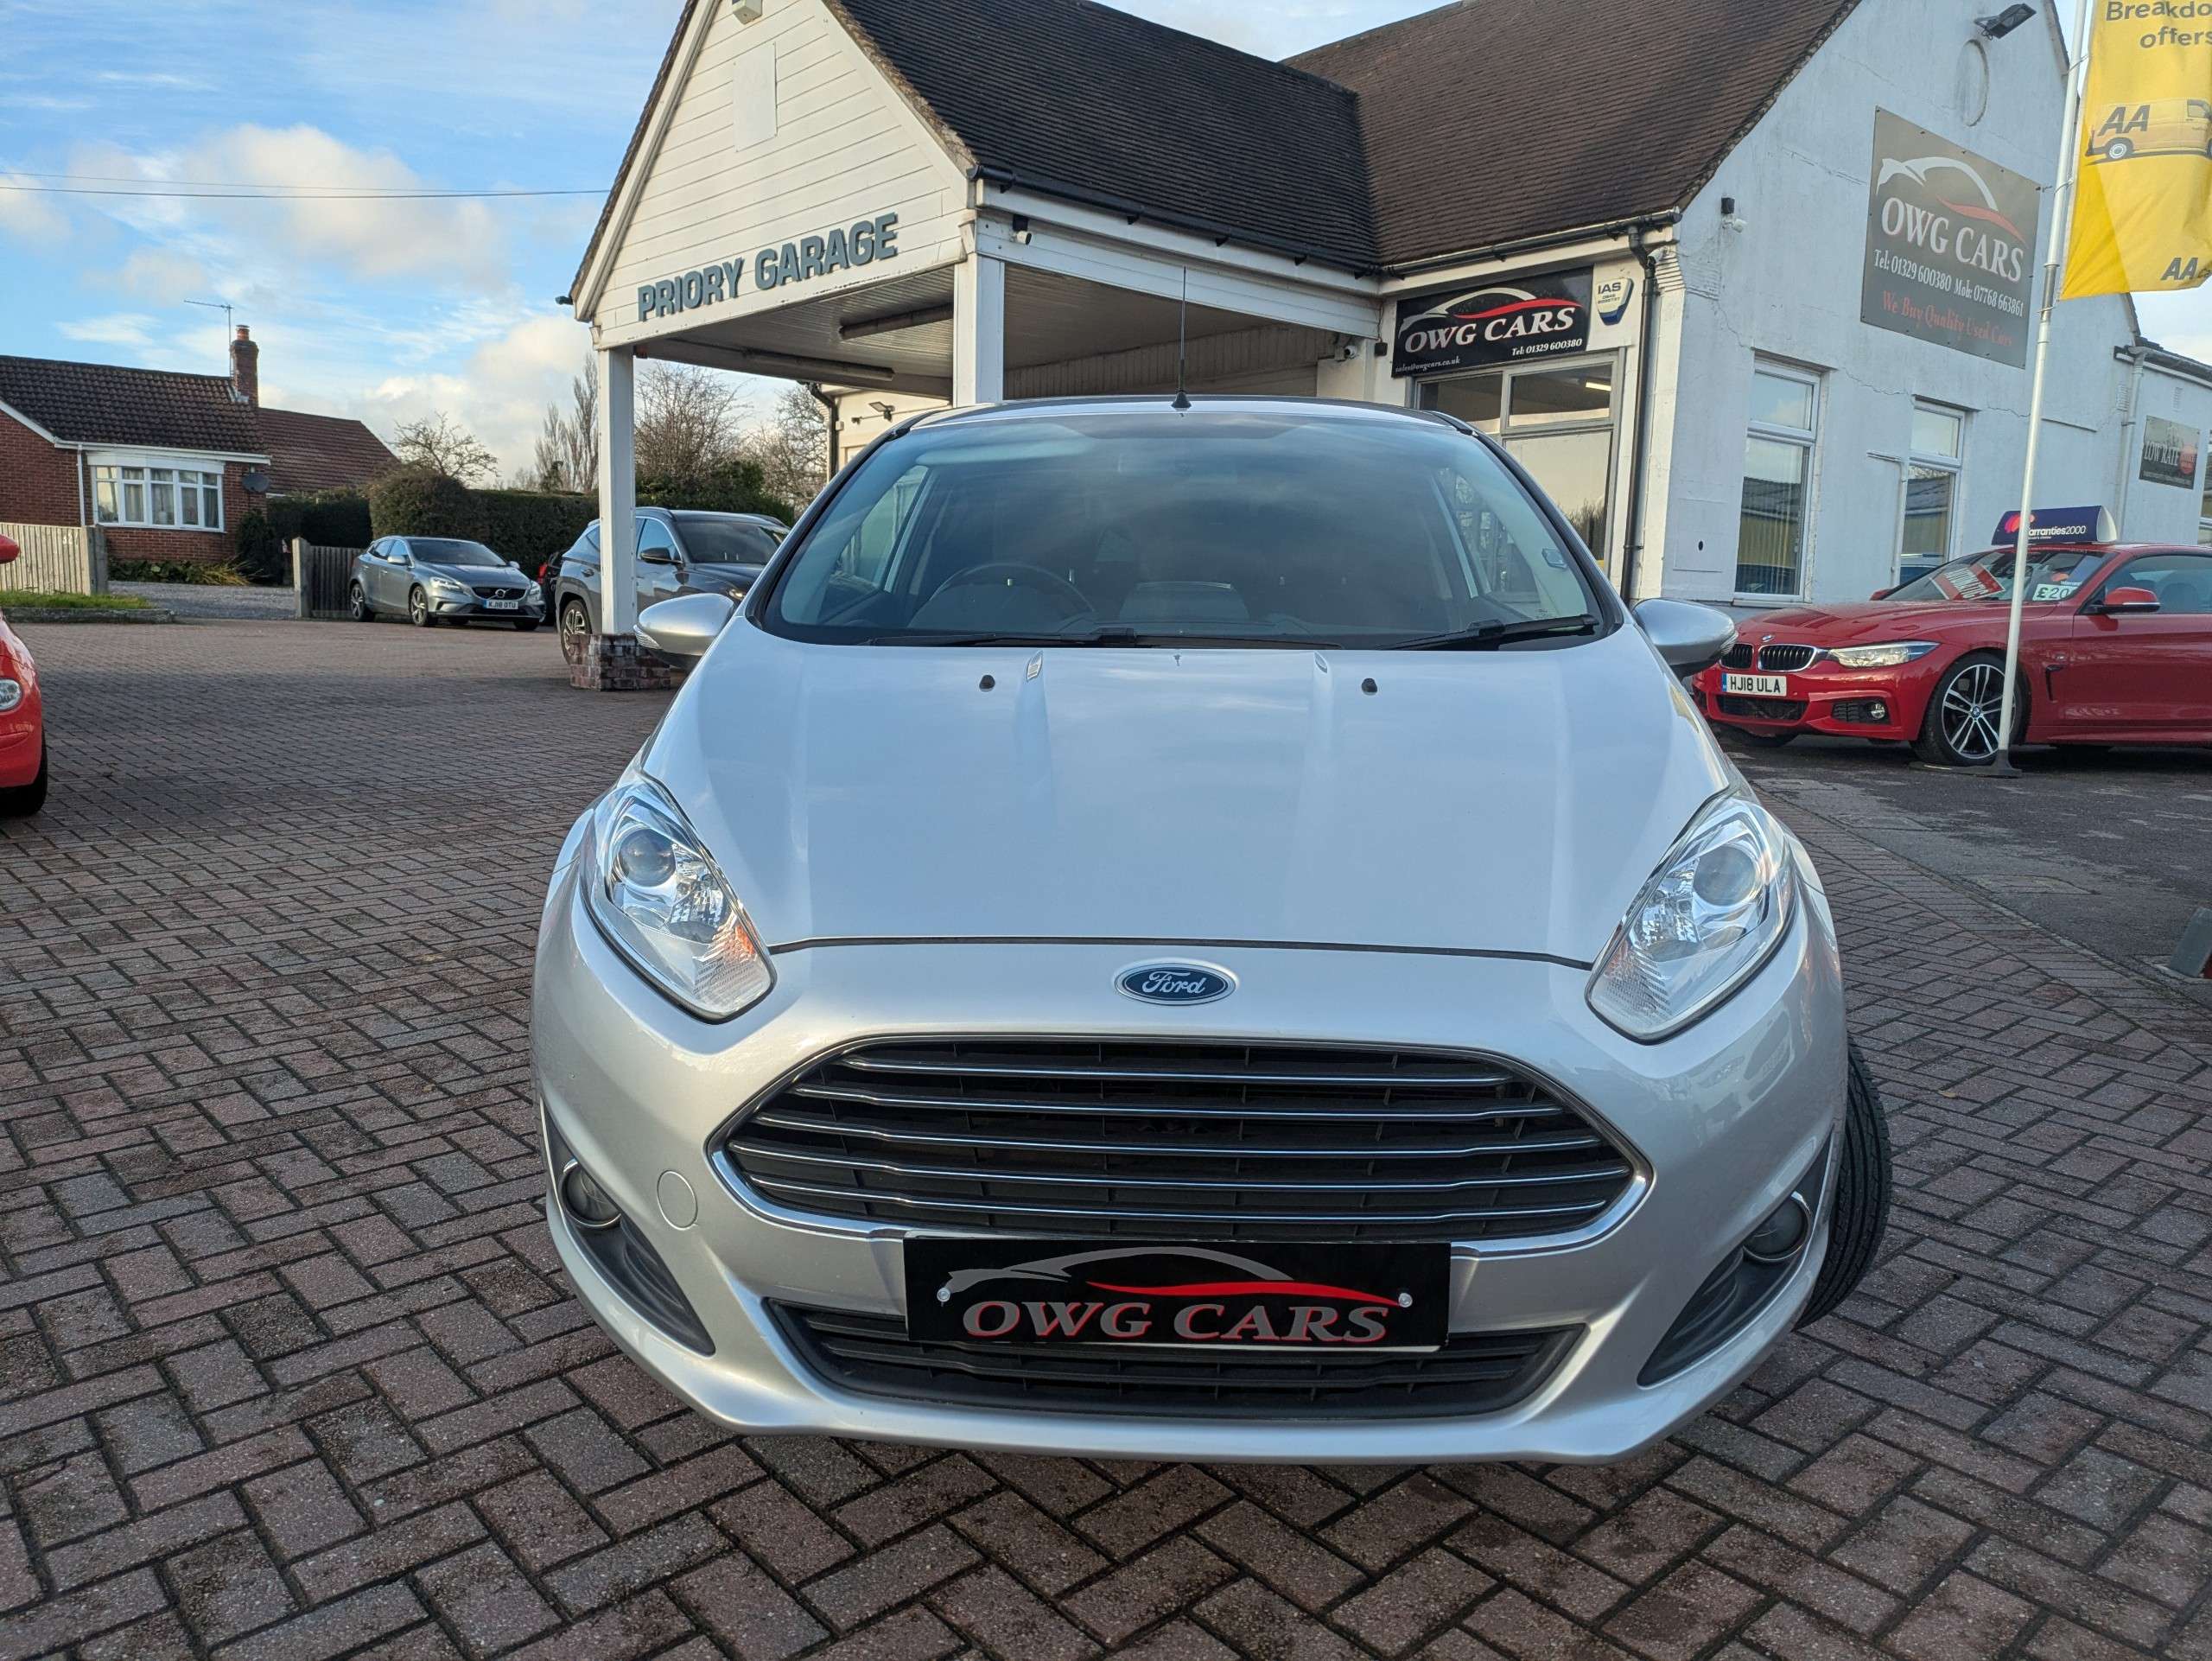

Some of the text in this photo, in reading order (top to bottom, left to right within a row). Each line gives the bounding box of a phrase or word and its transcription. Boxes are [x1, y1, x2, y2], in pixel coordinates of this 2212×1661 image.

[2106, 0, 2212, 21] Breakdo
[2139, 26, 2212, 48] offers
[2097, 104, 2151, 137] AA
[1881, 197, 2024, 282] OWG CARS
[638, 212, 899, 321] PRIORY GARAGE
[2161, 257, 2199, 281] AA
[1598, 282, 1621, 295] IAS
[1873, 249, 2024, 317] Tel: 01329 600380 Mob: 07768 663861
[1883, 290, 1898, 314] We
[1901, 297, 1923, 328] Buy
[1924, 304, 1965, 341] Quality
[1405, 307, 1576, 353] OWG CARS
[1512, 338, 1583, 356] Tel: 01329 600380
[2026, 525, 2088, 537] arranties2000
[1730, 676, 1781, 693] HJ18 ULA
[1142, 971, 1208, 994] Ford
[962, 1301, 1390, 1343] OWG CARS
